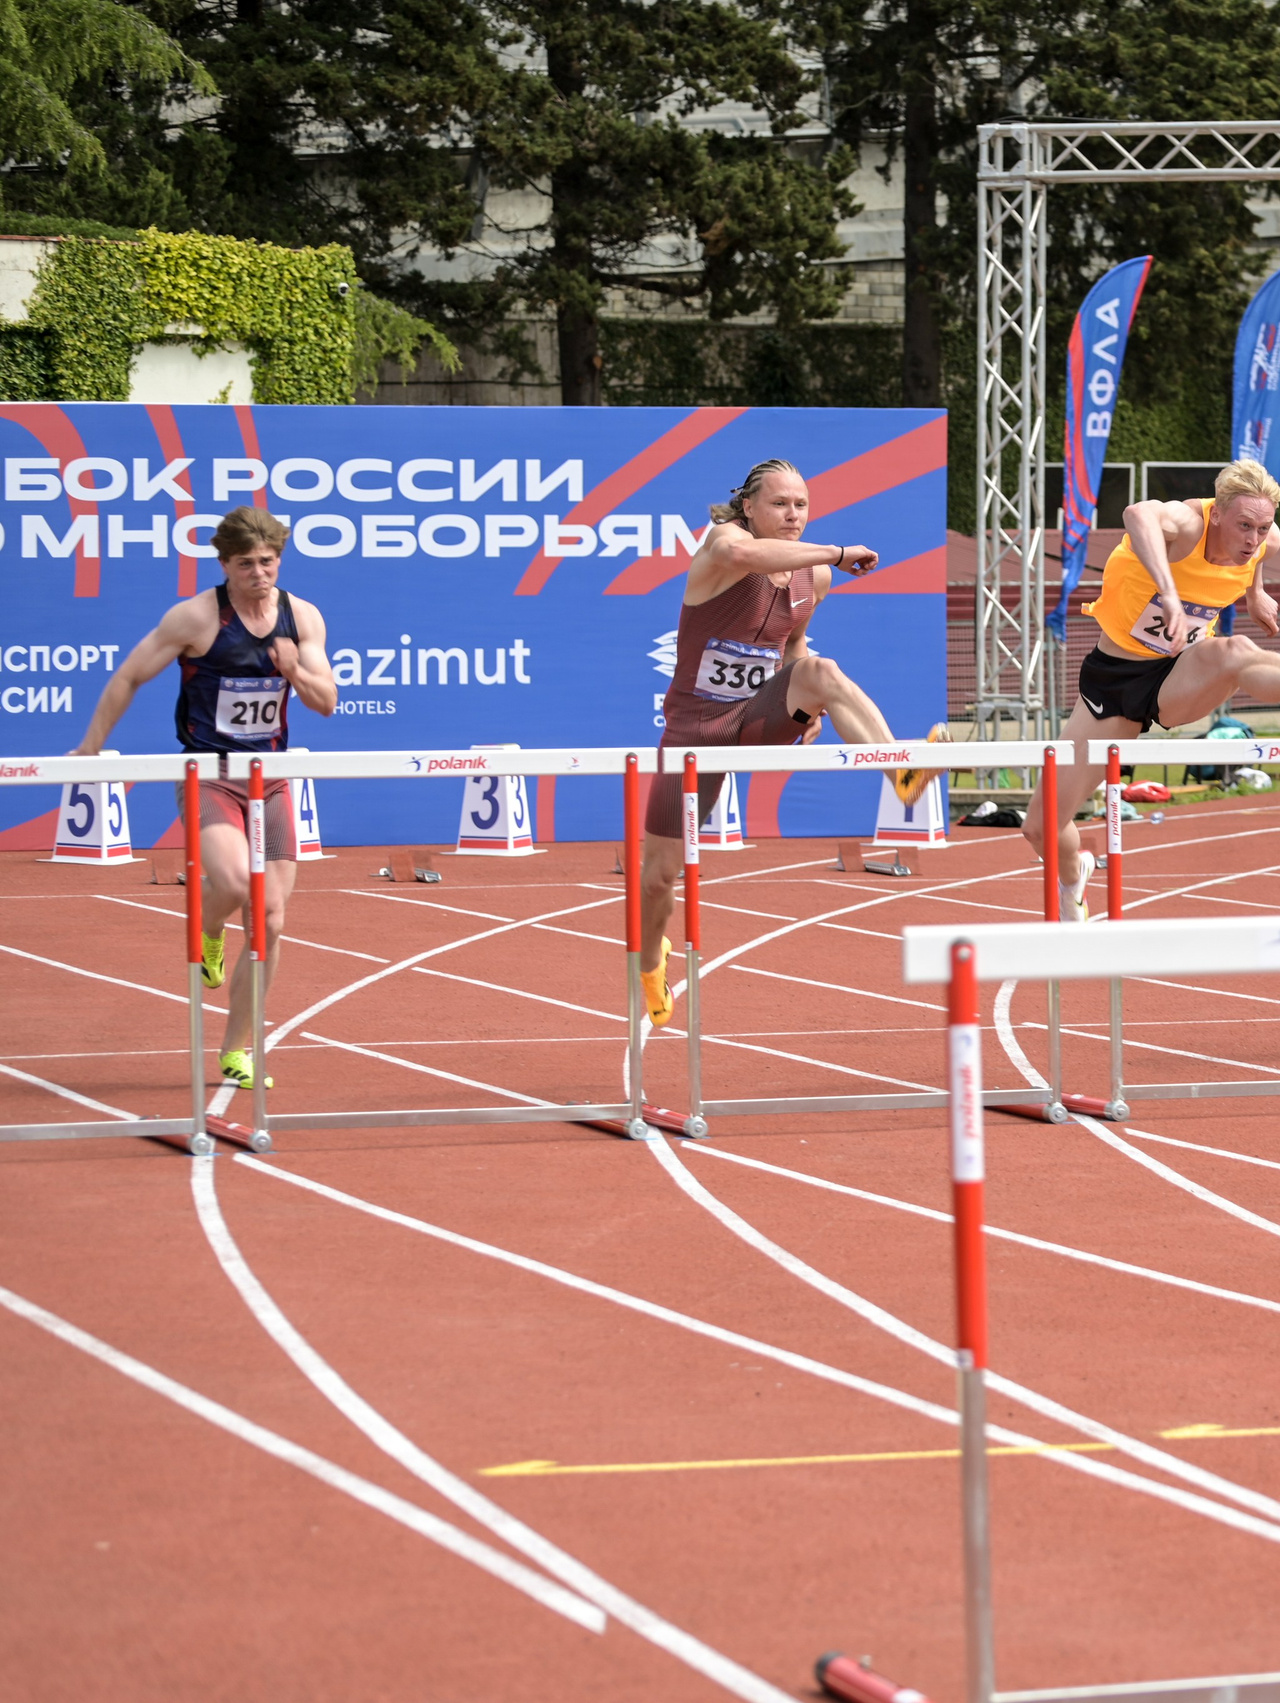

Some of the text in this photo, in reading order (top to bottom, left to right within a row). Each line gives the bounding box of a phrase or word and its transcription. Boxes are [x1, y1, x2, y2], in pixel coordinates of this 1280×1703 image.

[213, 457, 584, 502] РОССИИ
[21, 514, 714, 558] МНООБОРЬЯМ
[0, 645, 119, 672] СПОРТ
[332, 634, 531, 687] azimut
[708, 659, 766, 690] 330
[0, 686, 72, 713] СИИ
[230, 700, 278, 725] 210
[333, 700, 396, 714] HOTELS
[427, 756, 488, 773] polanik
[853, 749, 911, 765] polanik
[67, 783, 95, 838] 5
[108, 781, 122, 837] 5
[300, 778, 313, 834] 4
[471, 776, 500, 830] 3
[510, 775, 524, 829] 3
[1110, 801, 1120, 836] polanik
[254, 817, 264, 854] polanik
[687, 810, 697, 846] polanik
